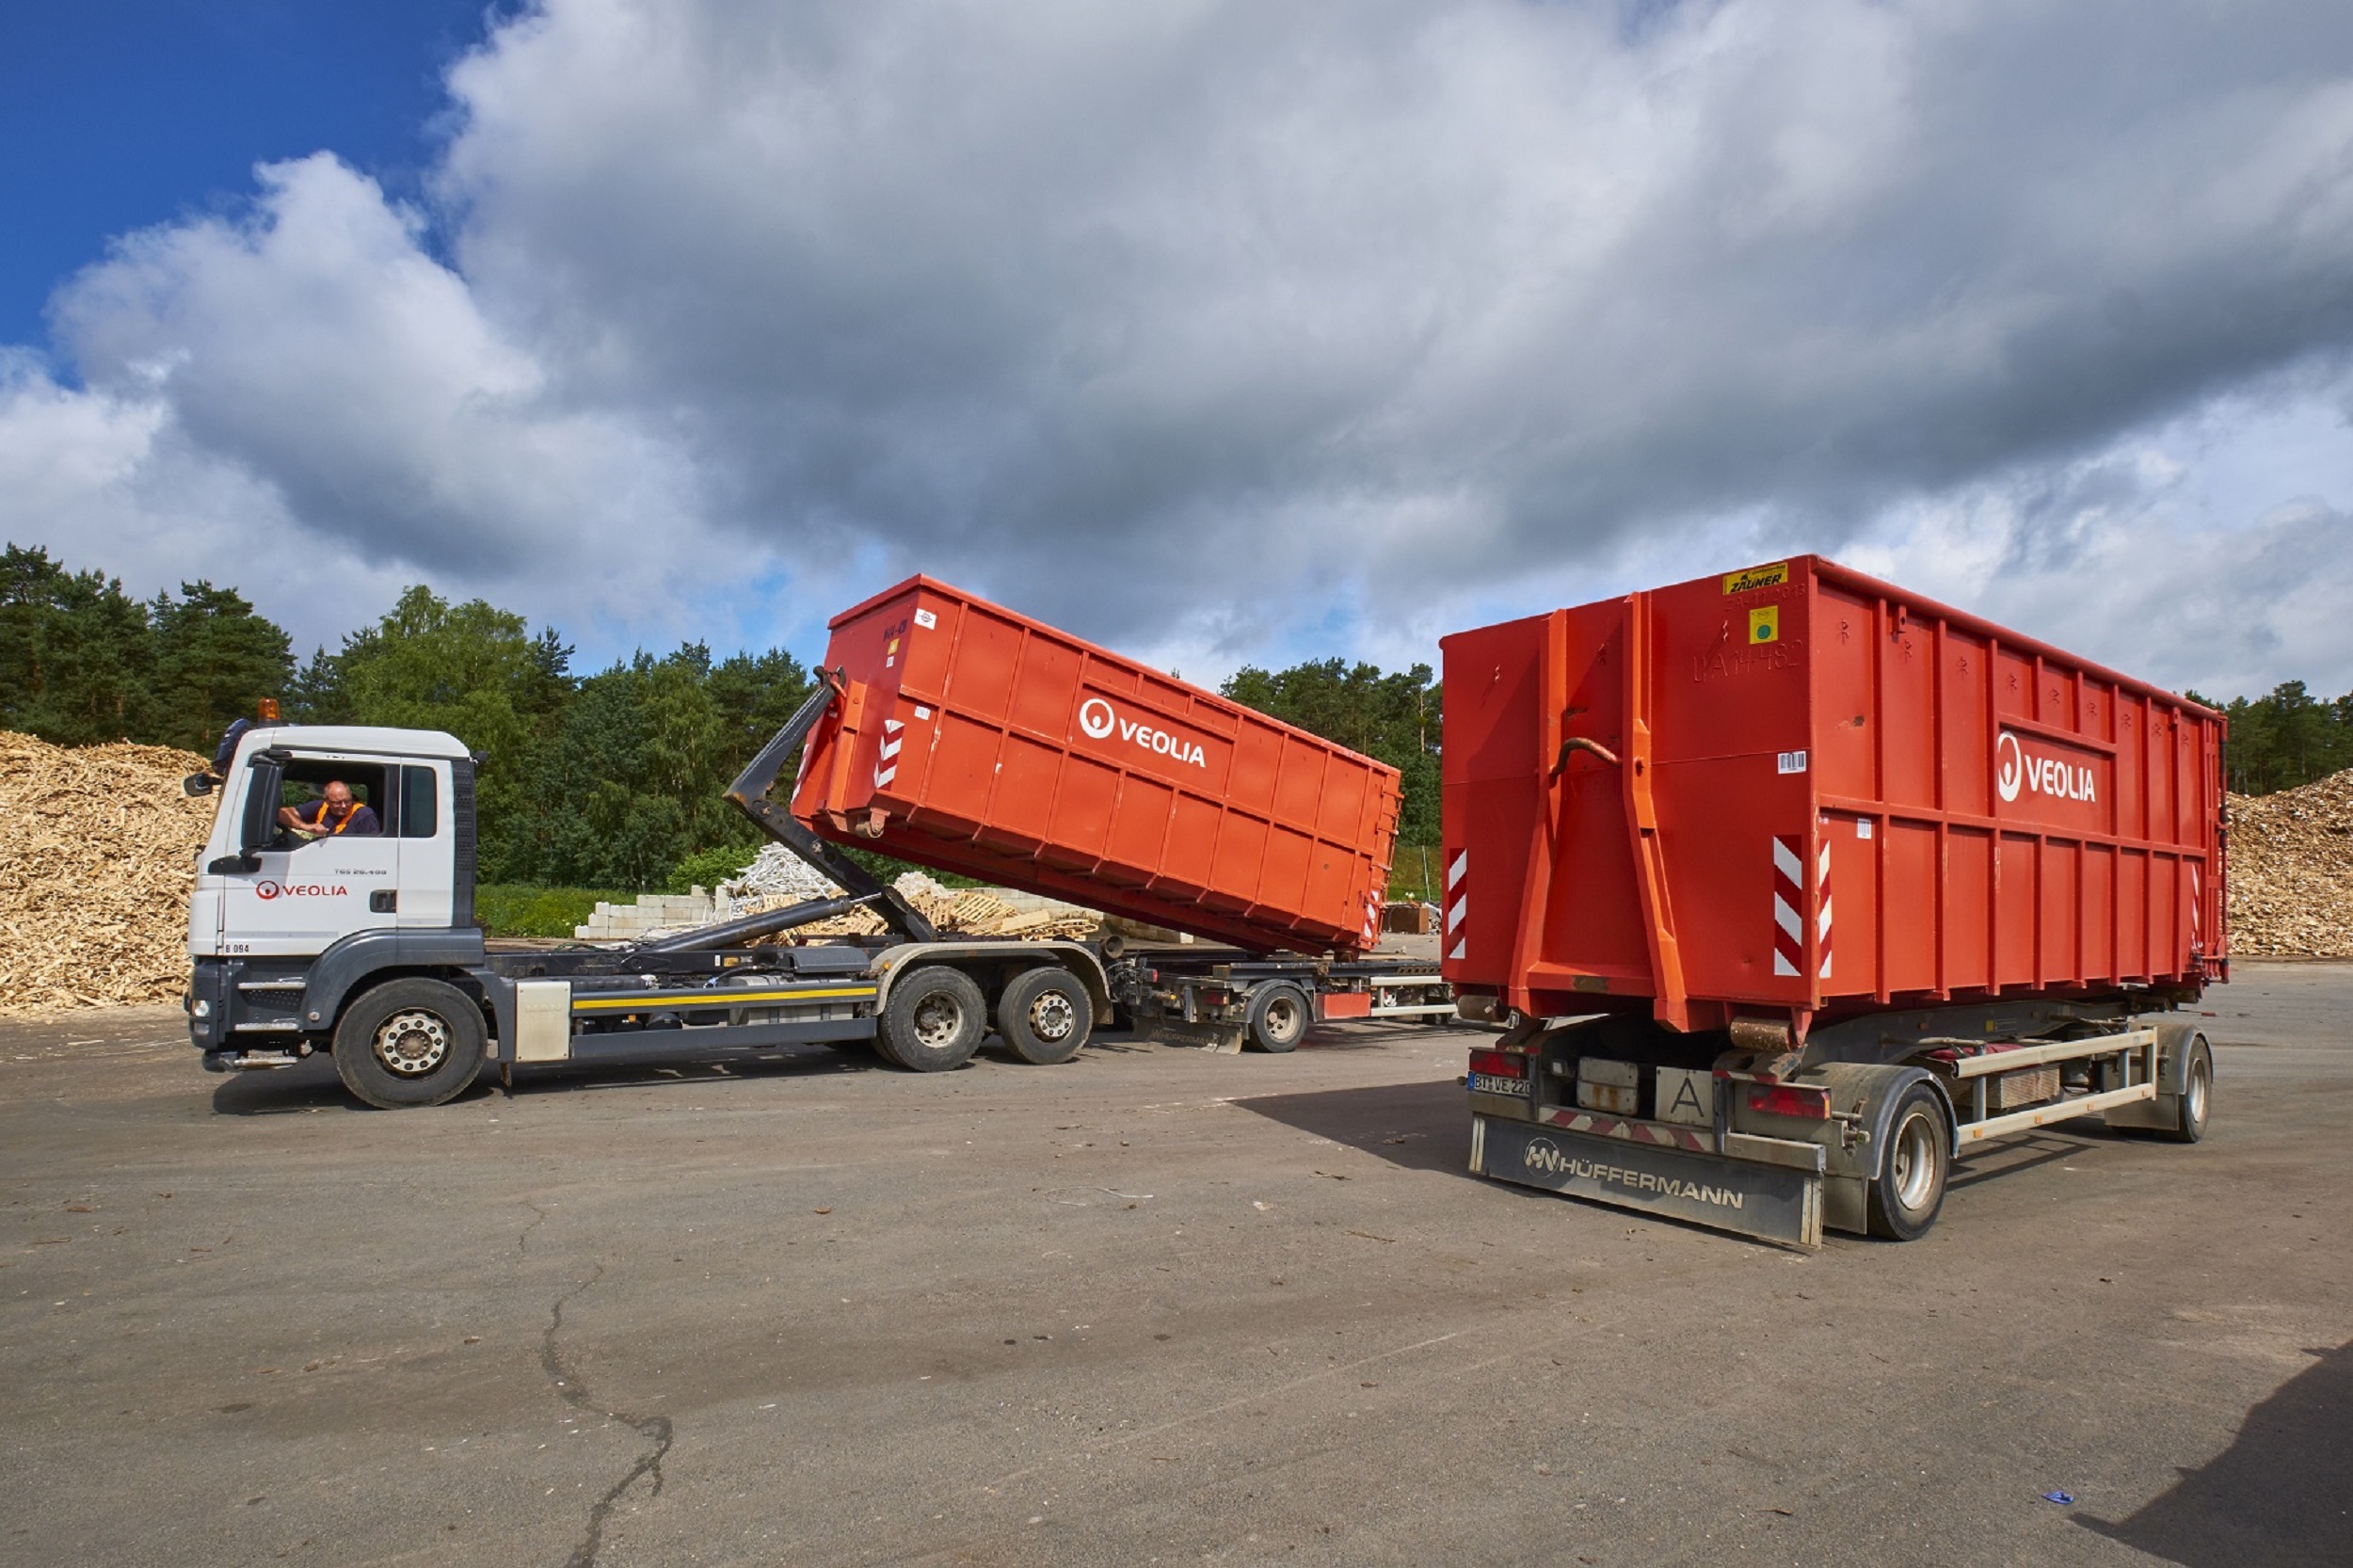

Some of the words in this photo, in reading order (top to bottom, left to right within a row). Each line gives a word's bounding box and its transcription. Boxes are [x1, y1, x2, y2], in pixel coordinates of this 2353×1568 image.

[1119, 717, 1206, 768] VEOLIA
[2025, 754, 2096, 803] VEOLIA
[282, 885, 348, 896] VEOLIA
[1495, 1078, 1510, 1093] VE
[1671, 1077, 1705, 1117] A
[1559, 1156, 1743, 1209] HÜFFERMANN
